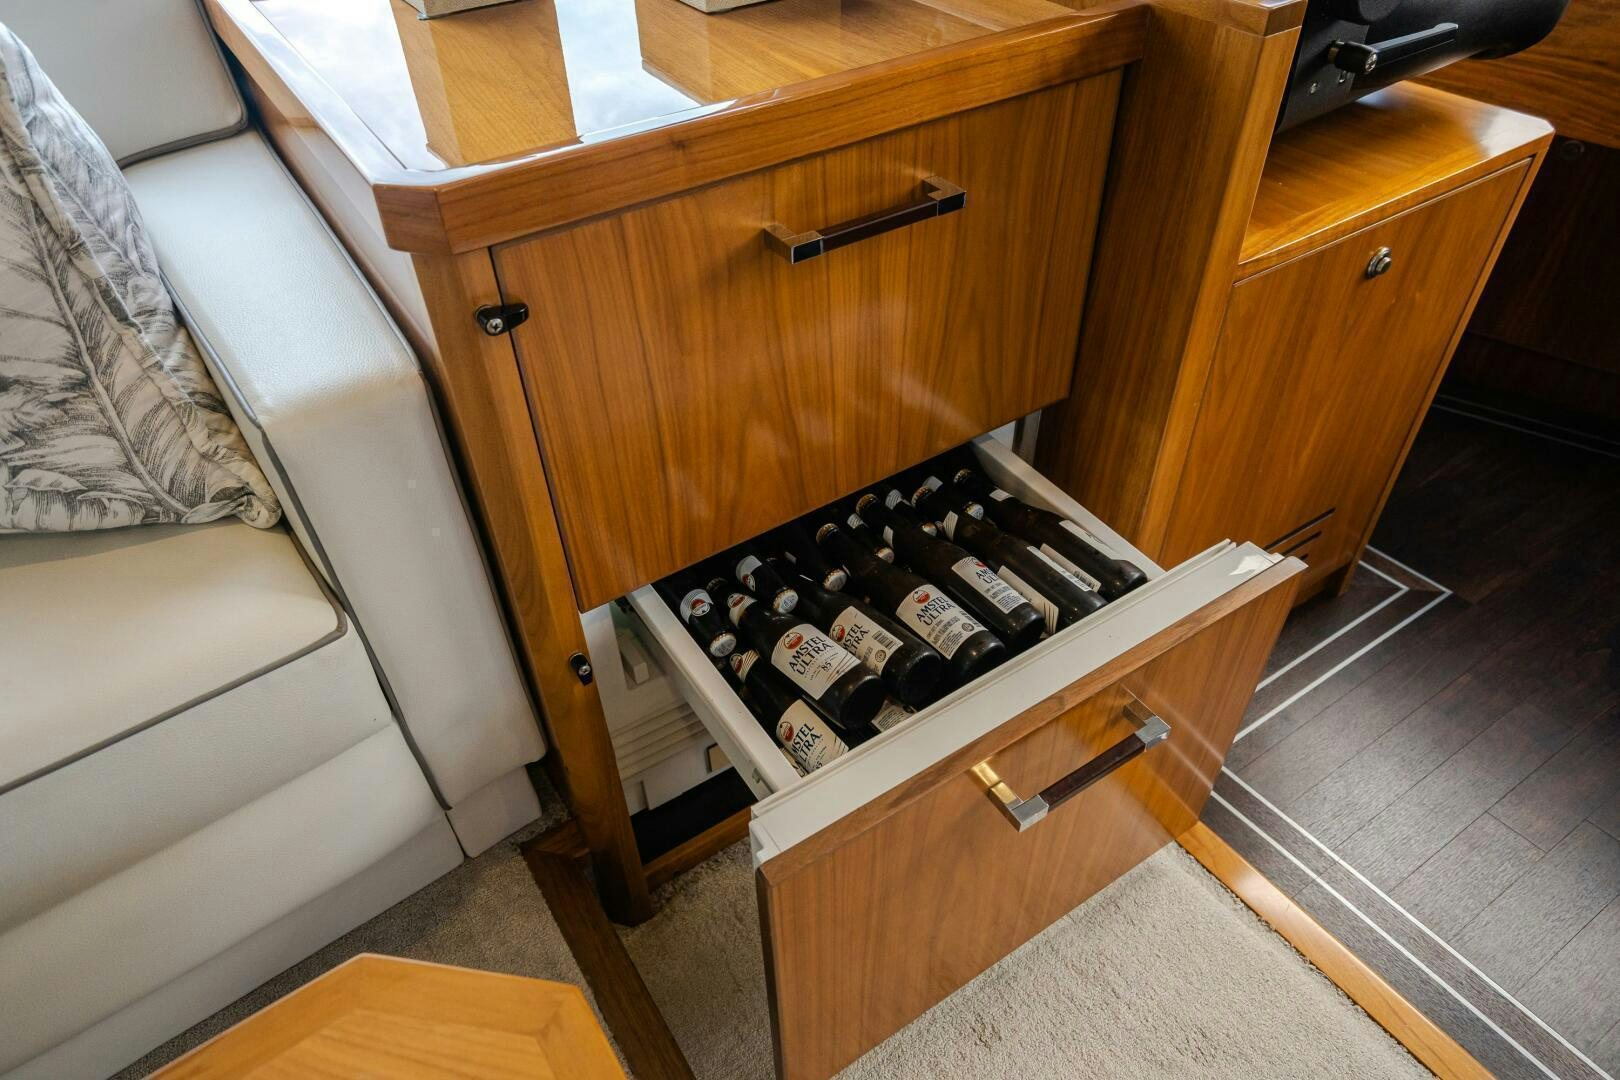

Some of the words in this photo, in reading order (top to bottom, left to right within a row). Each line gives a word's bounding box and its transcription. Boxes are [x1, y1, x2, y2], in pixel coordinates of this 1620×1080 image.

[916, 596, 948, 622] AMSTEL
[923, 602, 955, 626] ULTRA
[842, 624, 863, 650] MSTEL
[849, 629, 869, 656] LTRA
[788, 636, 825, 672] AMSTEL
[796, 643, 834, 675] ULTRA
[791, 723, 814, 755] MSTEL
[799, 733, 822, 762] LTRA
